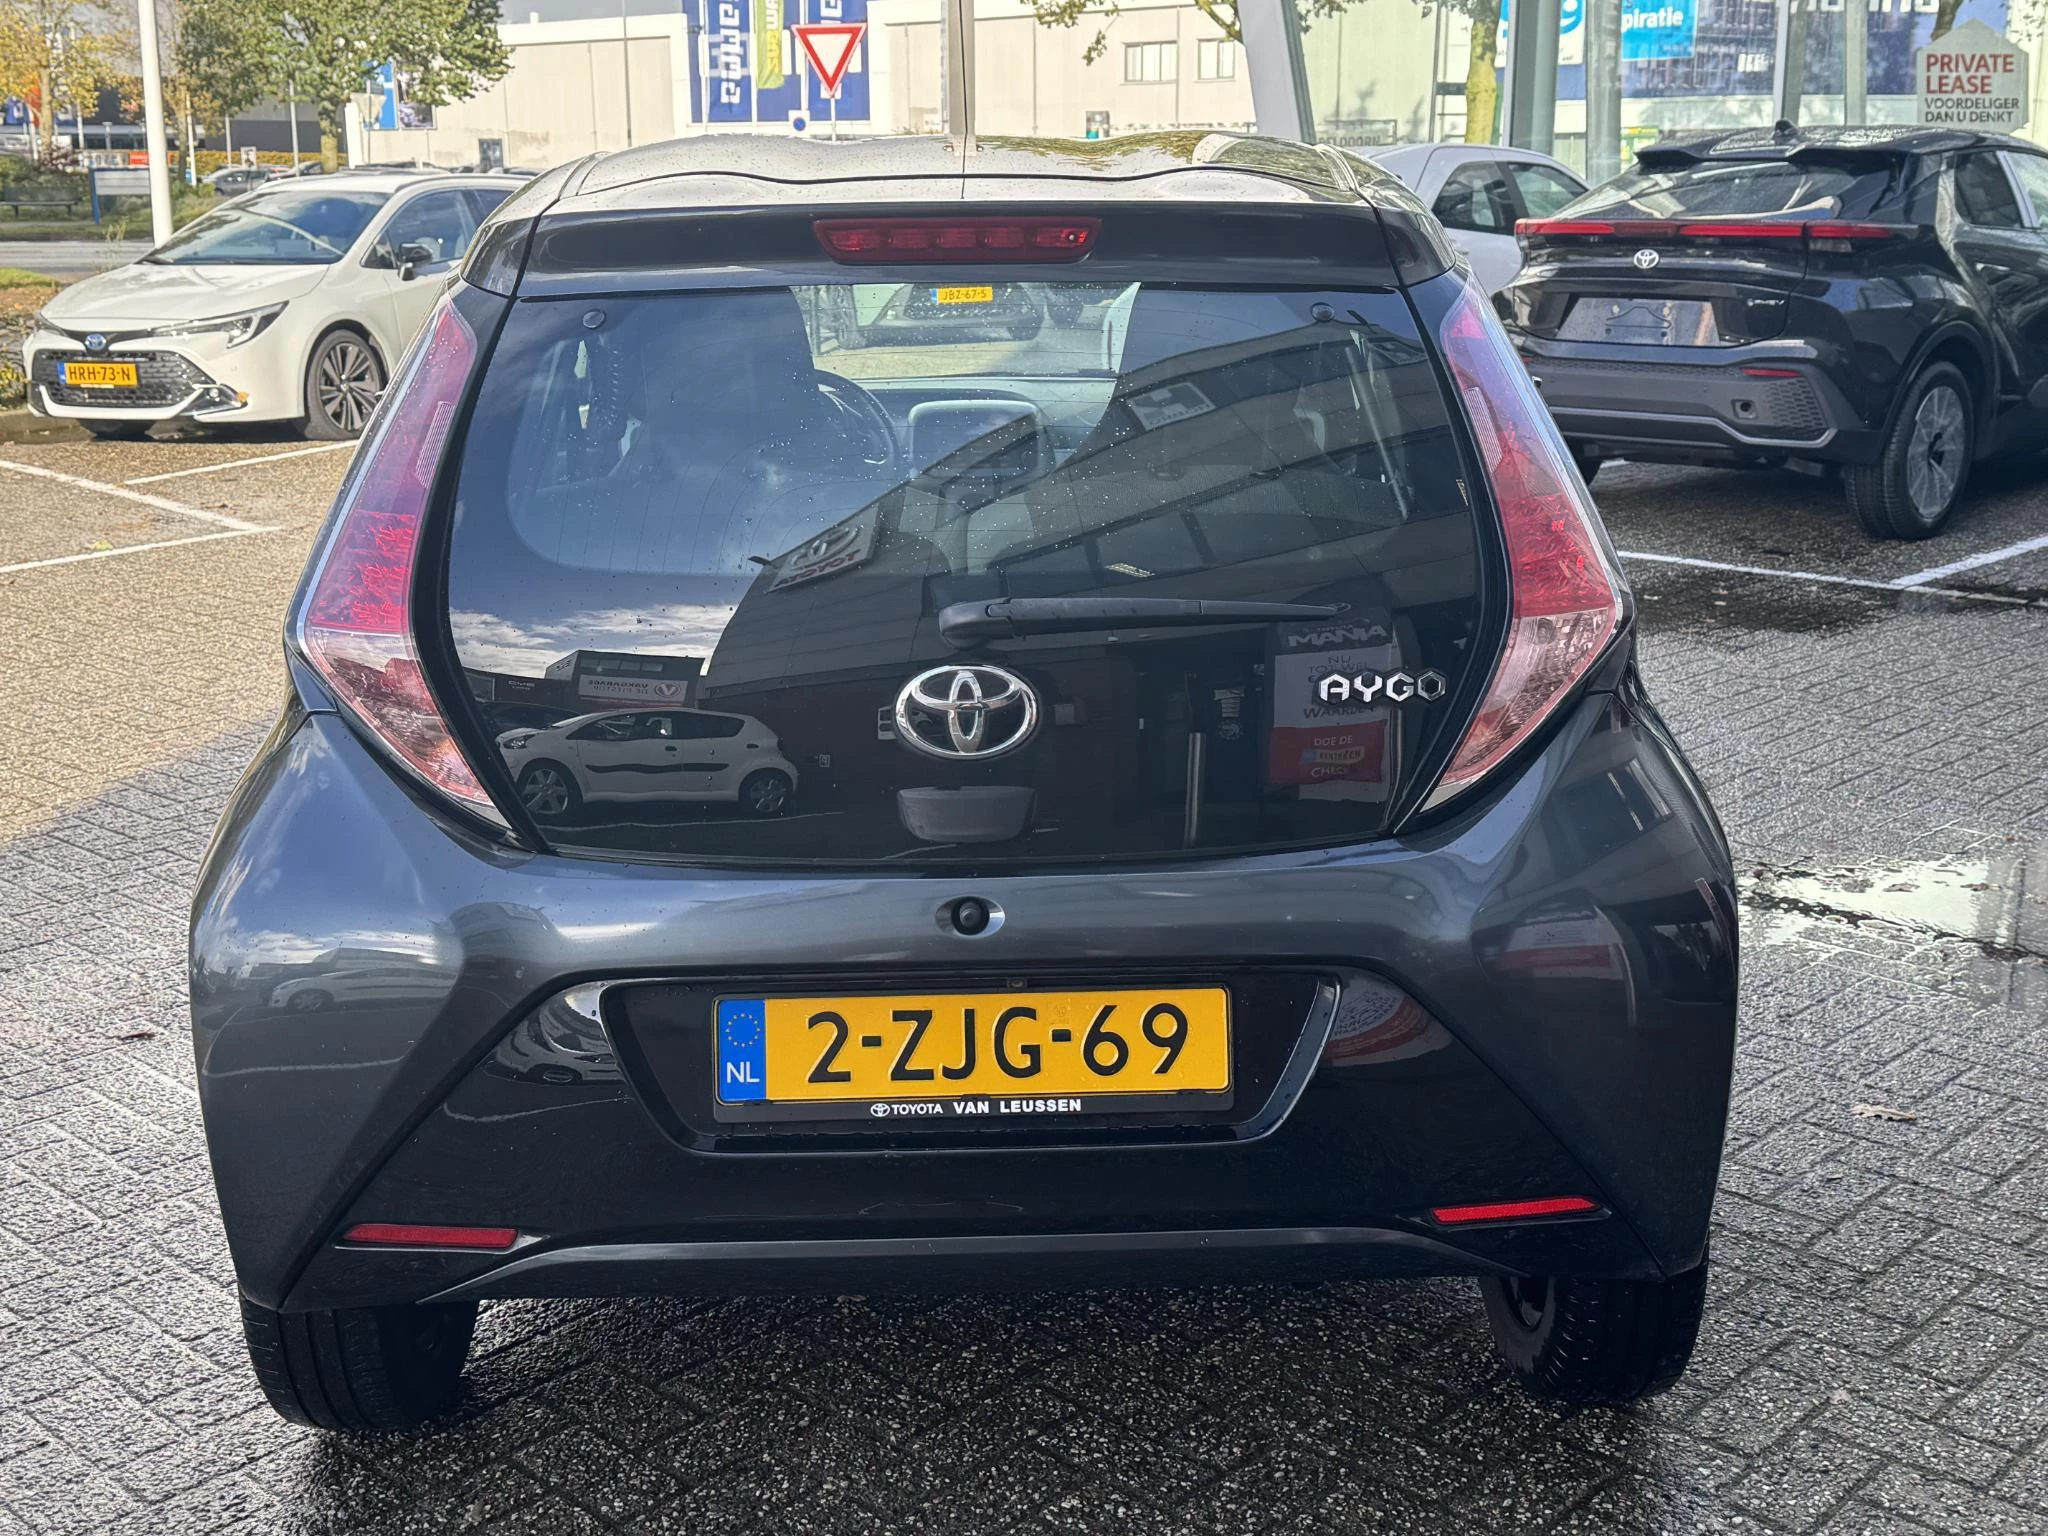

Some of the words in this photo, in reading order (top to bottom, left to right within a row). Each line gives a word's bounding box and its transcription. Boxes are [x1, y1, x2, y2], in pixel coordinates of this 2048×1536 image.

[1926, 53, 2015, 73] PRIVATE
[1926, 75, 1992, 94] LEASE
[1924, 97, 2019, 110] VOORDELIGER
[1925, 111, 1954, 122] DAN
[1957, 111, 1967, 122] U
[1969, 111, 2014, 122] DENKT
[68, 366, 131, 382] HRH-73-N
[1287, 624, 1389, 647] MANIA
[1318, 671, 1447, 703] AYGO
[726, 1061, 760, 1083] NL
[807, 1003, 1188, 1084] 2-ZJG-69
[891, 1103, 943, 1115] TOYOTA
[953, 1101, 989, 1114] VAN
[1000, 1099, 1081, 1113] LEUSSEN
